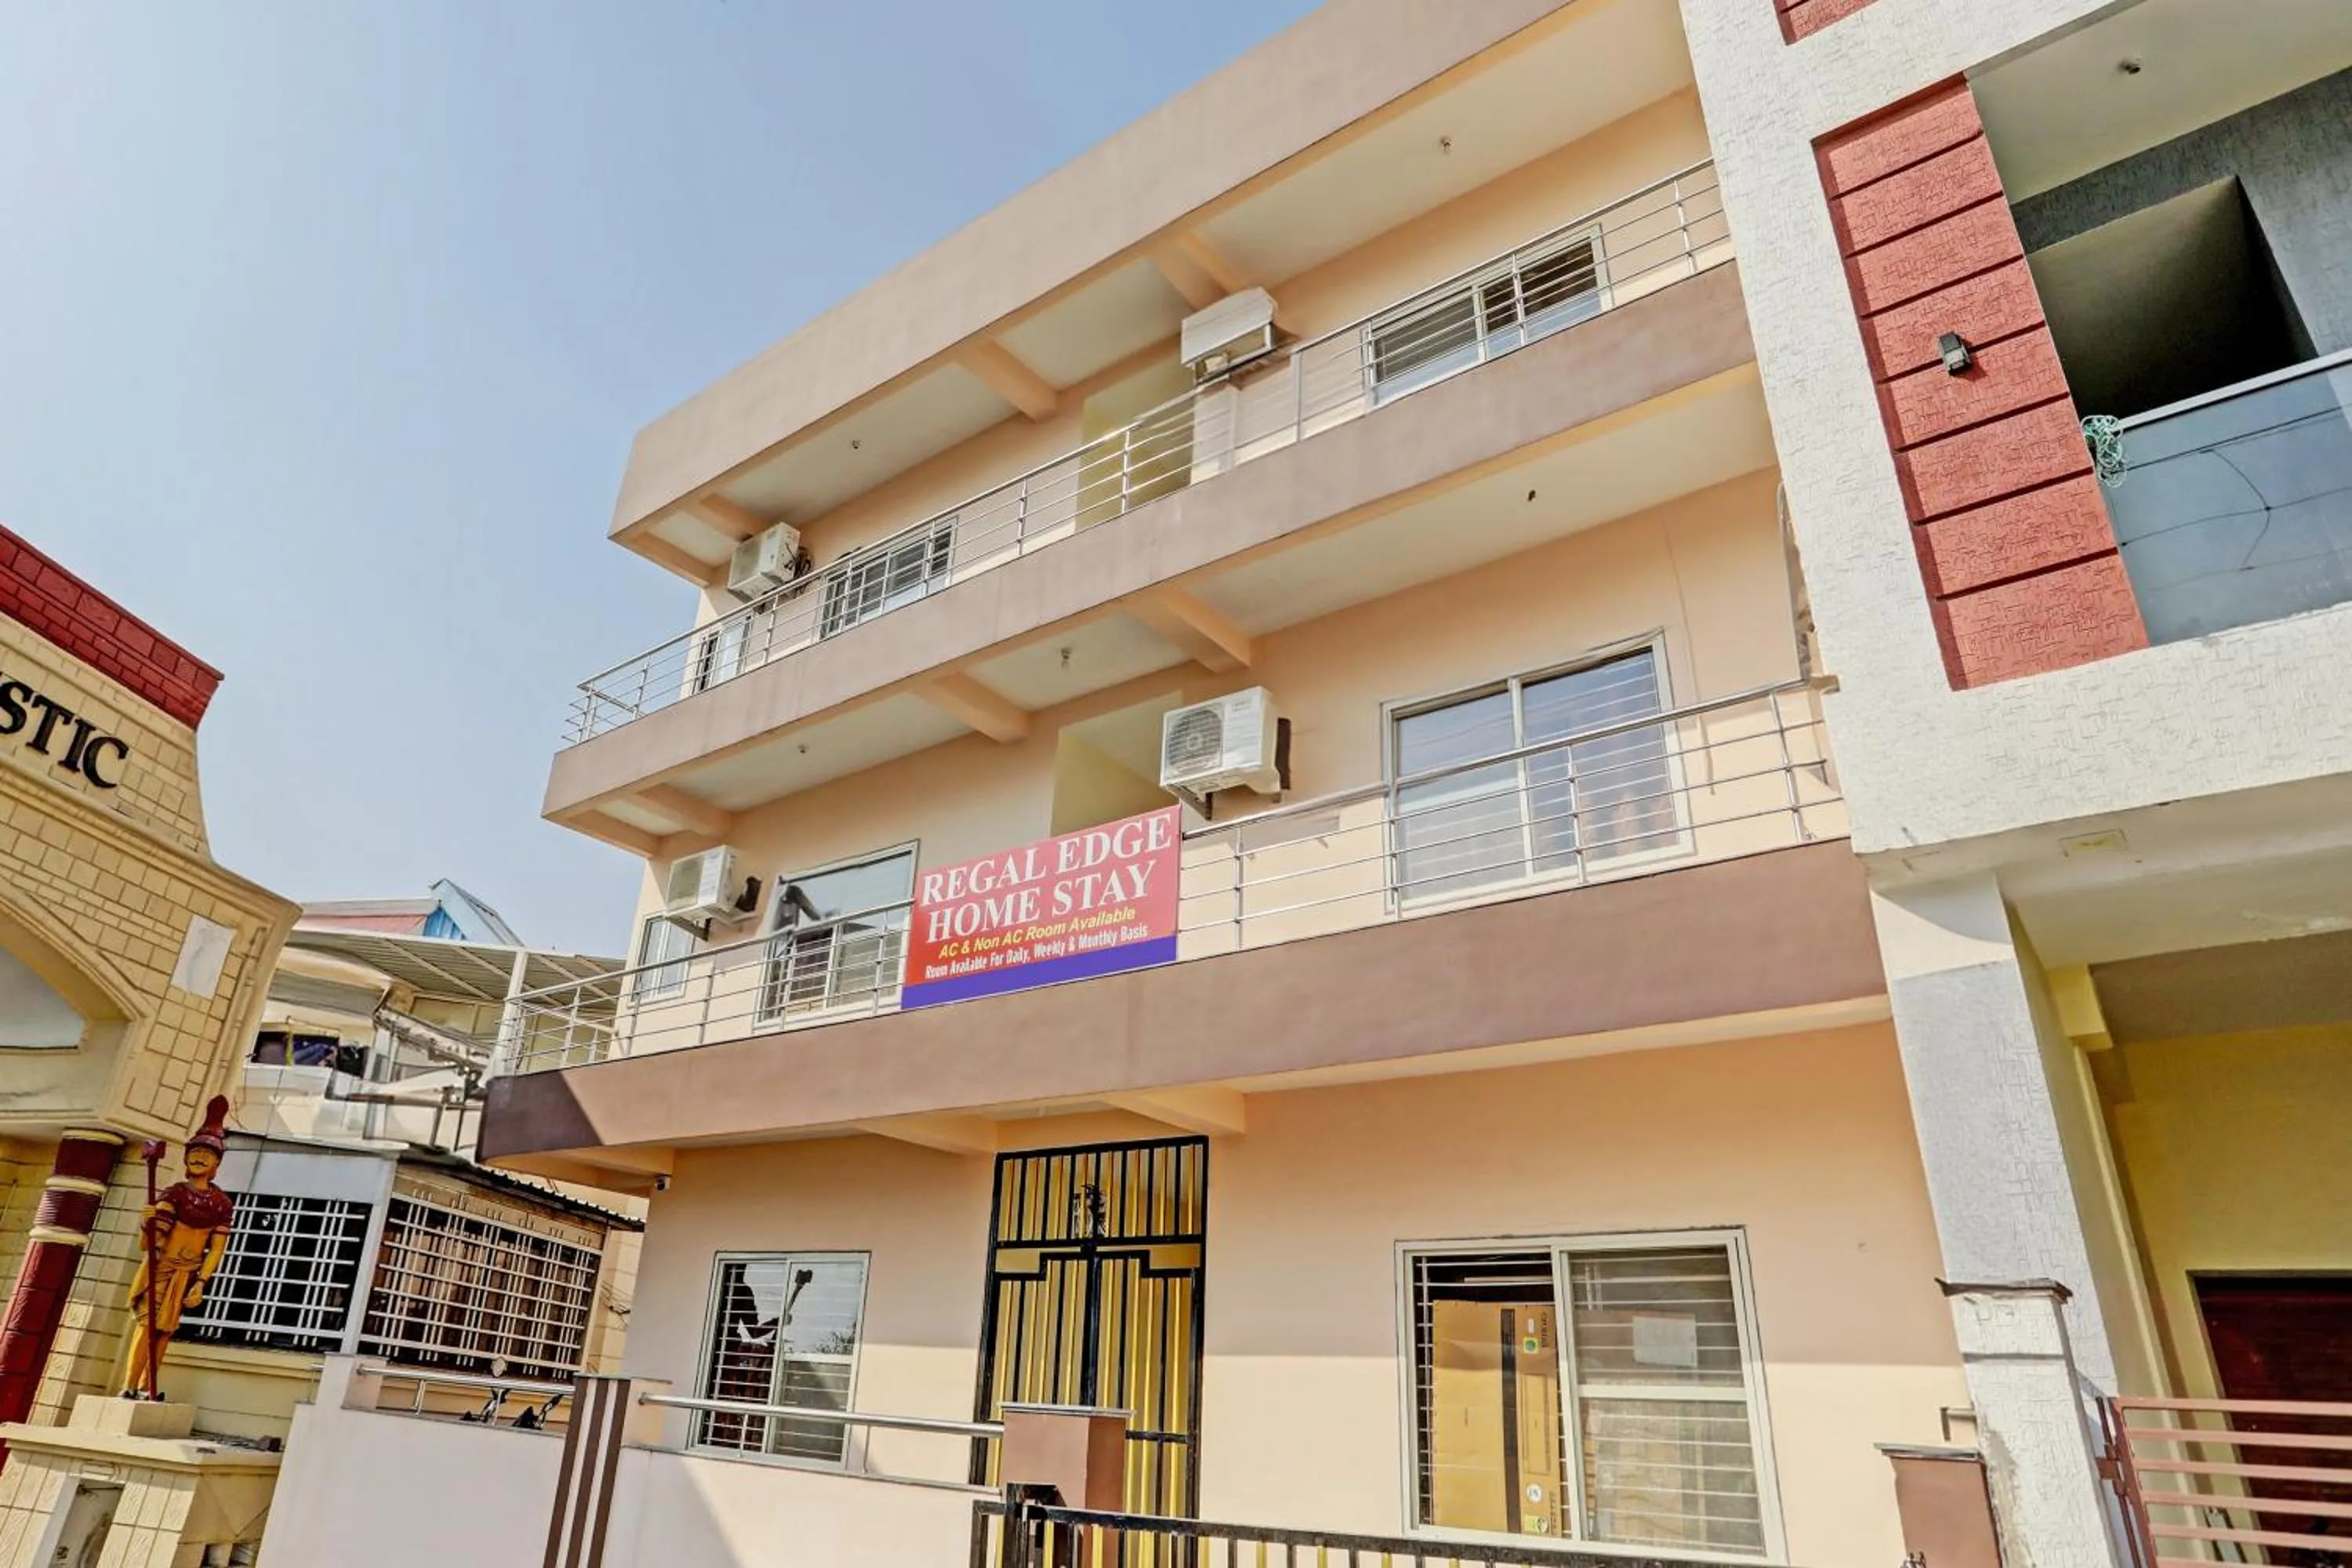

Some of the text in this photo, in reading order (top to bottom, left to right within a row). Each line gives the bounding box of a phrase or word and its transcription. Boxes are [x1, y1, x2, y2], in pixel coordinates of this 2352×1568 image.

[0, 679, 129, 789] STIC
[921, 813, 1172, 907] REGAL EDGE
[926, 860, 1156, 944] HOME STAY
[925, 965, 948, 979] Room
[949, 955, 987, 975] Available
[990, 951, 1004, 967] For
[1034, 940, 1065, 959] Weekly
[1068, 935, 1076, 952] &
[1078, 928, 1117, 949] Monthly
[1120, 921, 1149, 942] Basis
[938, 906, 1136, 959] AC & Non AC Room Available
